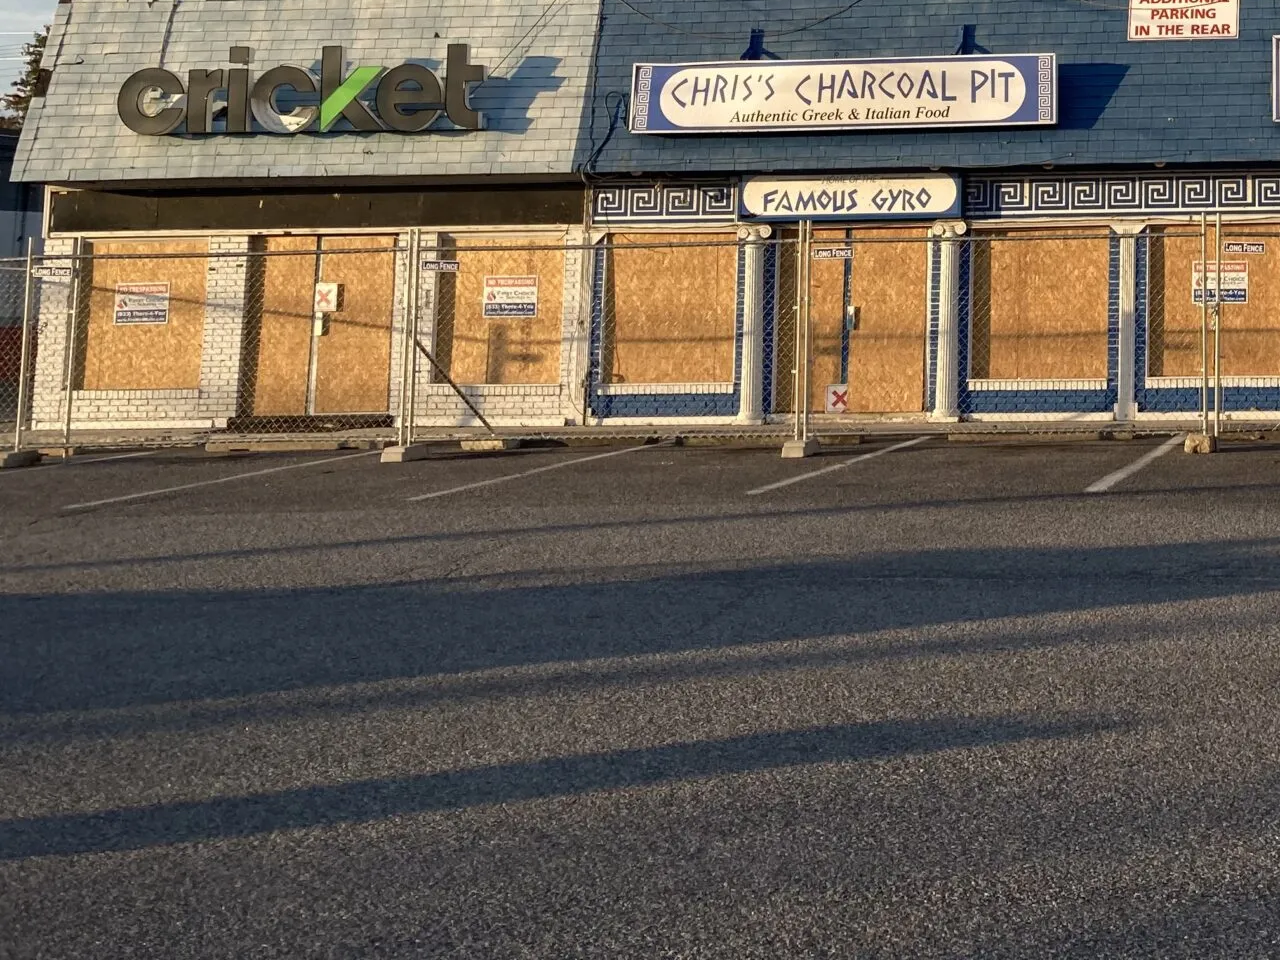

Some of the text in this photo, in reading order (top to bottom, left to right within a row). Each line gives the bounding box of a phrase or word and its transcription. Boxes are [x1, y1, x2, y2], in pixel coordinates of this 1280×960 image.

[1151, 8, 1216, 20] PARKING
[1134, 24, 1231, 36] IN THE REAR
[117, 44, 485, 135] cricket
[671, 68, 1015, 108] CHRIS'S CHARCOAL PIT
[730, 106, 951, 123] Authentic Greek & Italian Food
[763, 187, 932, 212] FAMOUS GYRO
[832, 249, 852, 257] FENCE
[1226, 243, 1263, 252] LONG FENCE
[34, 267, 71, 276] LONG FENCE
[423, 261, 459, 270] LONG FENCE
